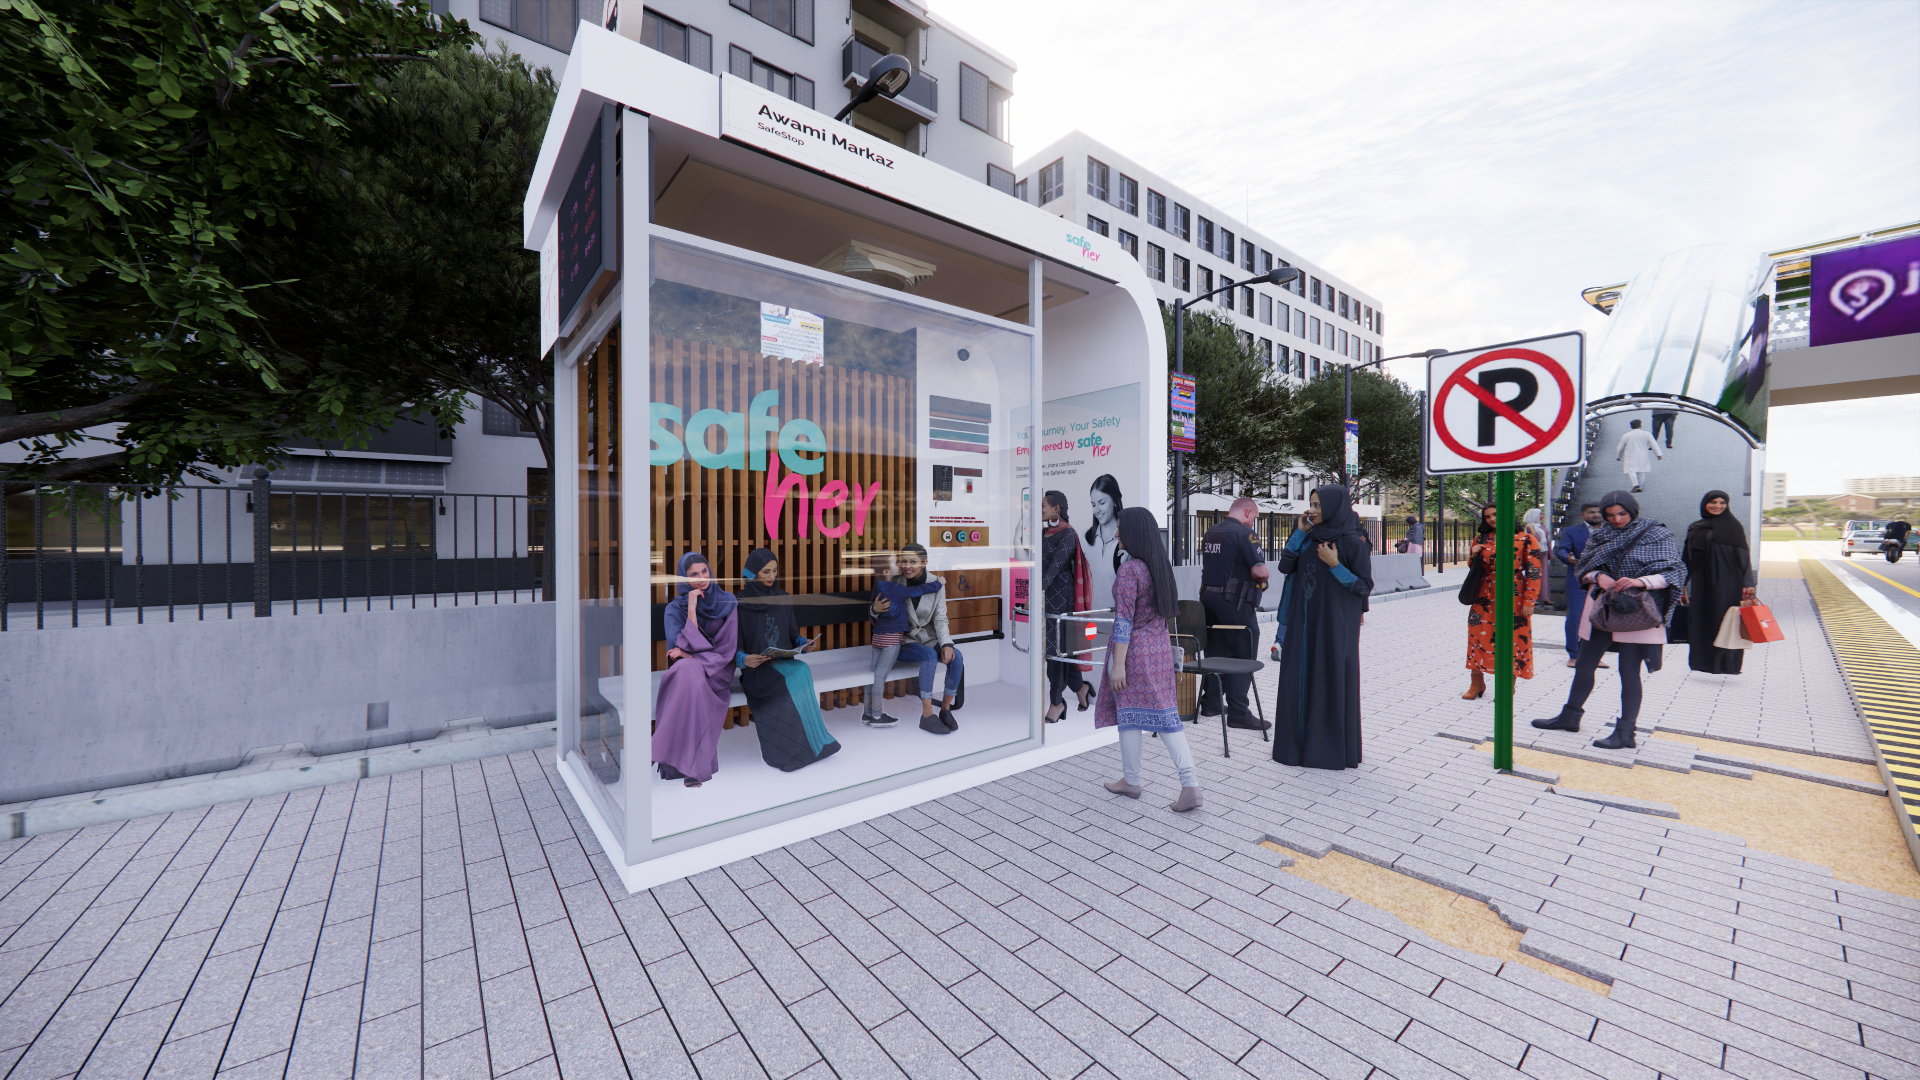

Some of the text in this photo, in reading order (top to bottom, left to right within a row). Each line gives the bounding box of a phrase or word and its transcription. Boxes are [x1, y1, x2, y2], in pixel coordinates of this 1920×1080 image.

[758, 121, 805, 146] SafeStop
[758, 104, 895, 169] Awami Markaz
[1066, 233, 1092, 251] safe
[1082, 245, 1101, 262] her
[650, 389, 827, 475] safe
[1016, 431, 1030, 441] You
[1069, 421, 1091, 432] Your
[1092, 415, 1121, 428] Safety
[1064, 440, 1076, 451] by
[1077, 432, 1103, 448] safe
[1092, 442, 1112, 458] her
[764, 451, 881, 540] her
